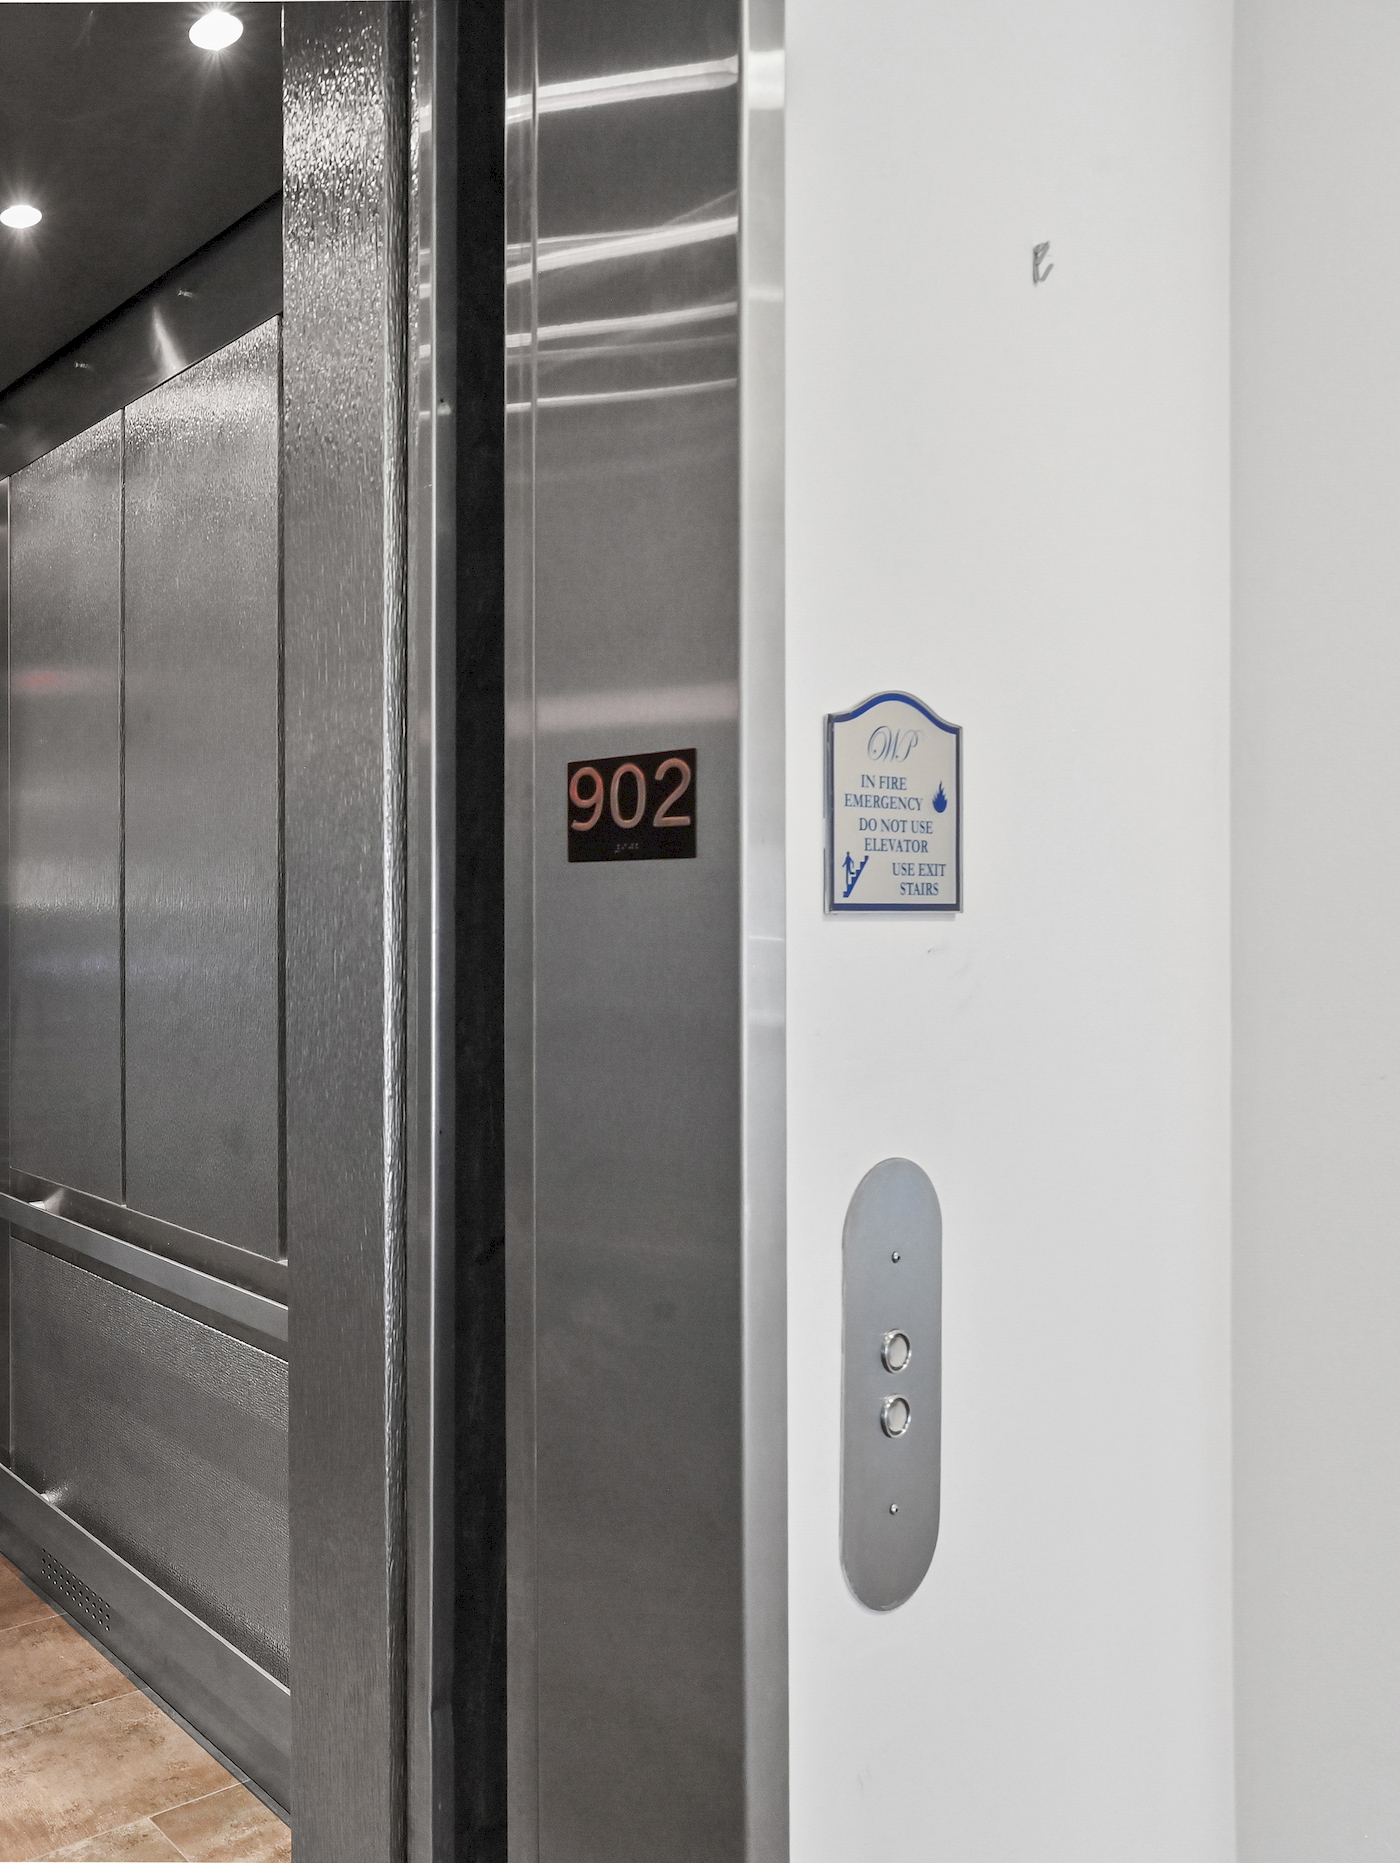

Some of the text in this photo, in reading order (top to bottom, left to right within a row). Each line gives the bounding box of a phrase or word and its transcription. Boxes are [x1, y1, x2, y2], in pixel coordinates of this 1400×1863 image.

[861, 774, 907, 790] IN FIRE
[570, 758, 691, 831] 902
[844, 794, 923, 811] EMERGENCY
[859, 818, 933, 834] DO NOT USE
[864, 838, 928, 853] ELEVATOR
[892, 863, 946, 876] USE EXIT
[900, 882, 939, 896] STAIRS
